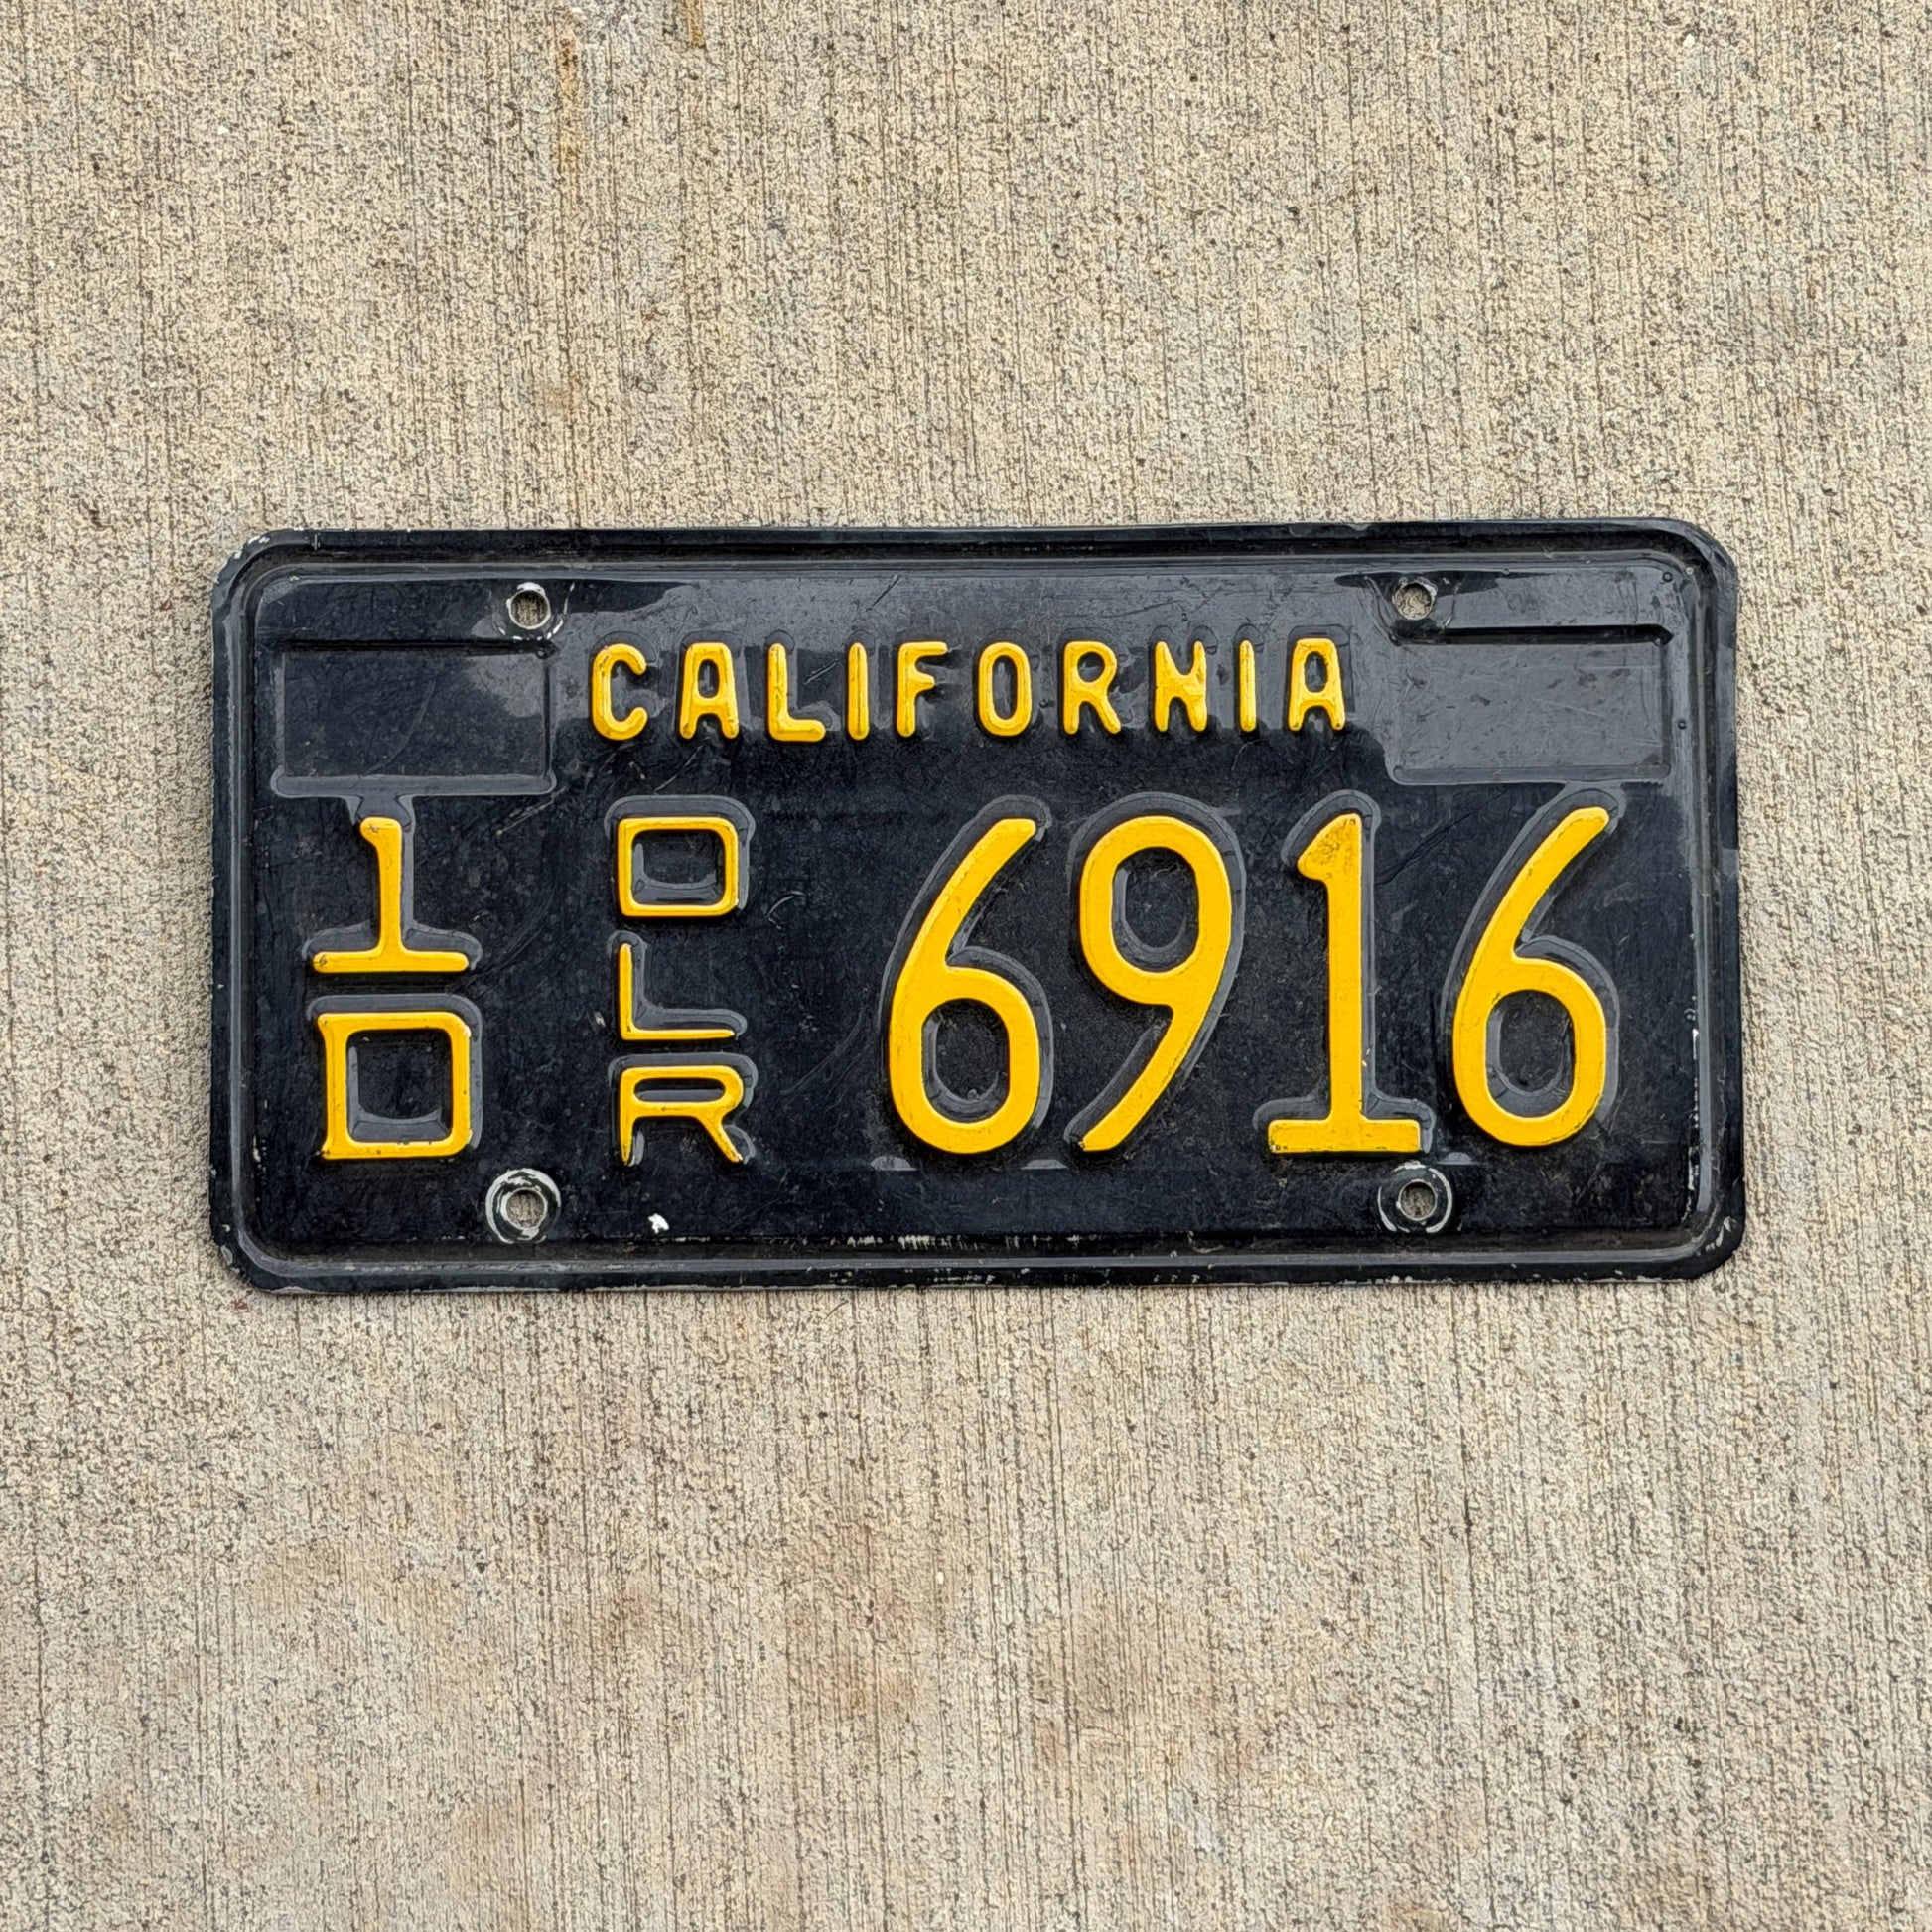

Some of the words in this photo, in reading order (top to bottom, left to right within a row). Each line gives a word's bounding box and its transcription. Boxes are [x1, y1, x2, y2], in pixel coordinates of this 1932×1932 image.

[590, 639, 1353, 743] CALIFORNIA
[616, 814, 749, 1166] DLR
[887, 804, 1612, 1157] 6916
